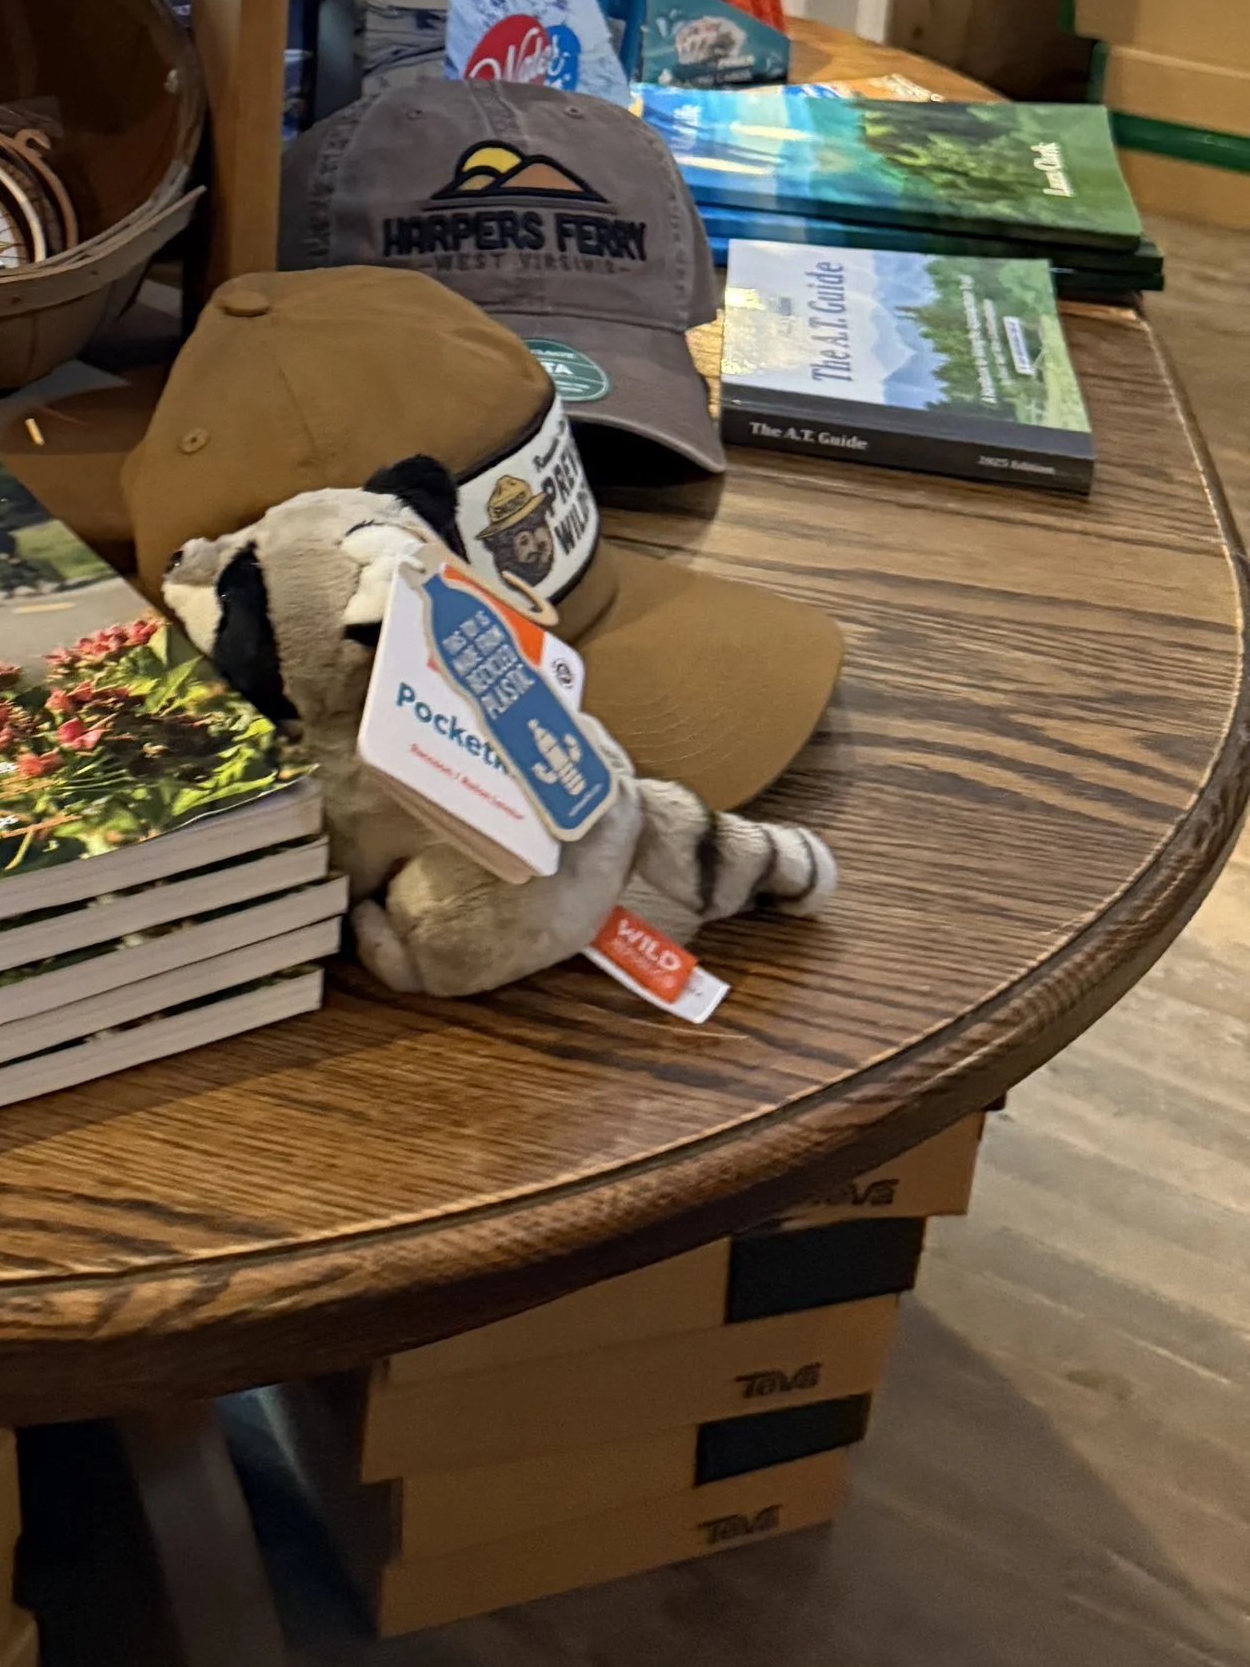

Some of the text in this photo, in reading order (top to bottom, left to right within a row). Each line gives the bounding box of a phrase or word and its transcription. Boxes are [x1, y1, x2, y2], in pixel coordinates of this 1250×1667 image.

[383, 210, 647, 261] HARPERS FERRY
[804, 260, 852, 383] The A.T. Guide
[750, 421, 869, 452] The A.T. Guide
[480, 662, 536, 722] PLASTIC
[617, 918, 683, 972] WILD
